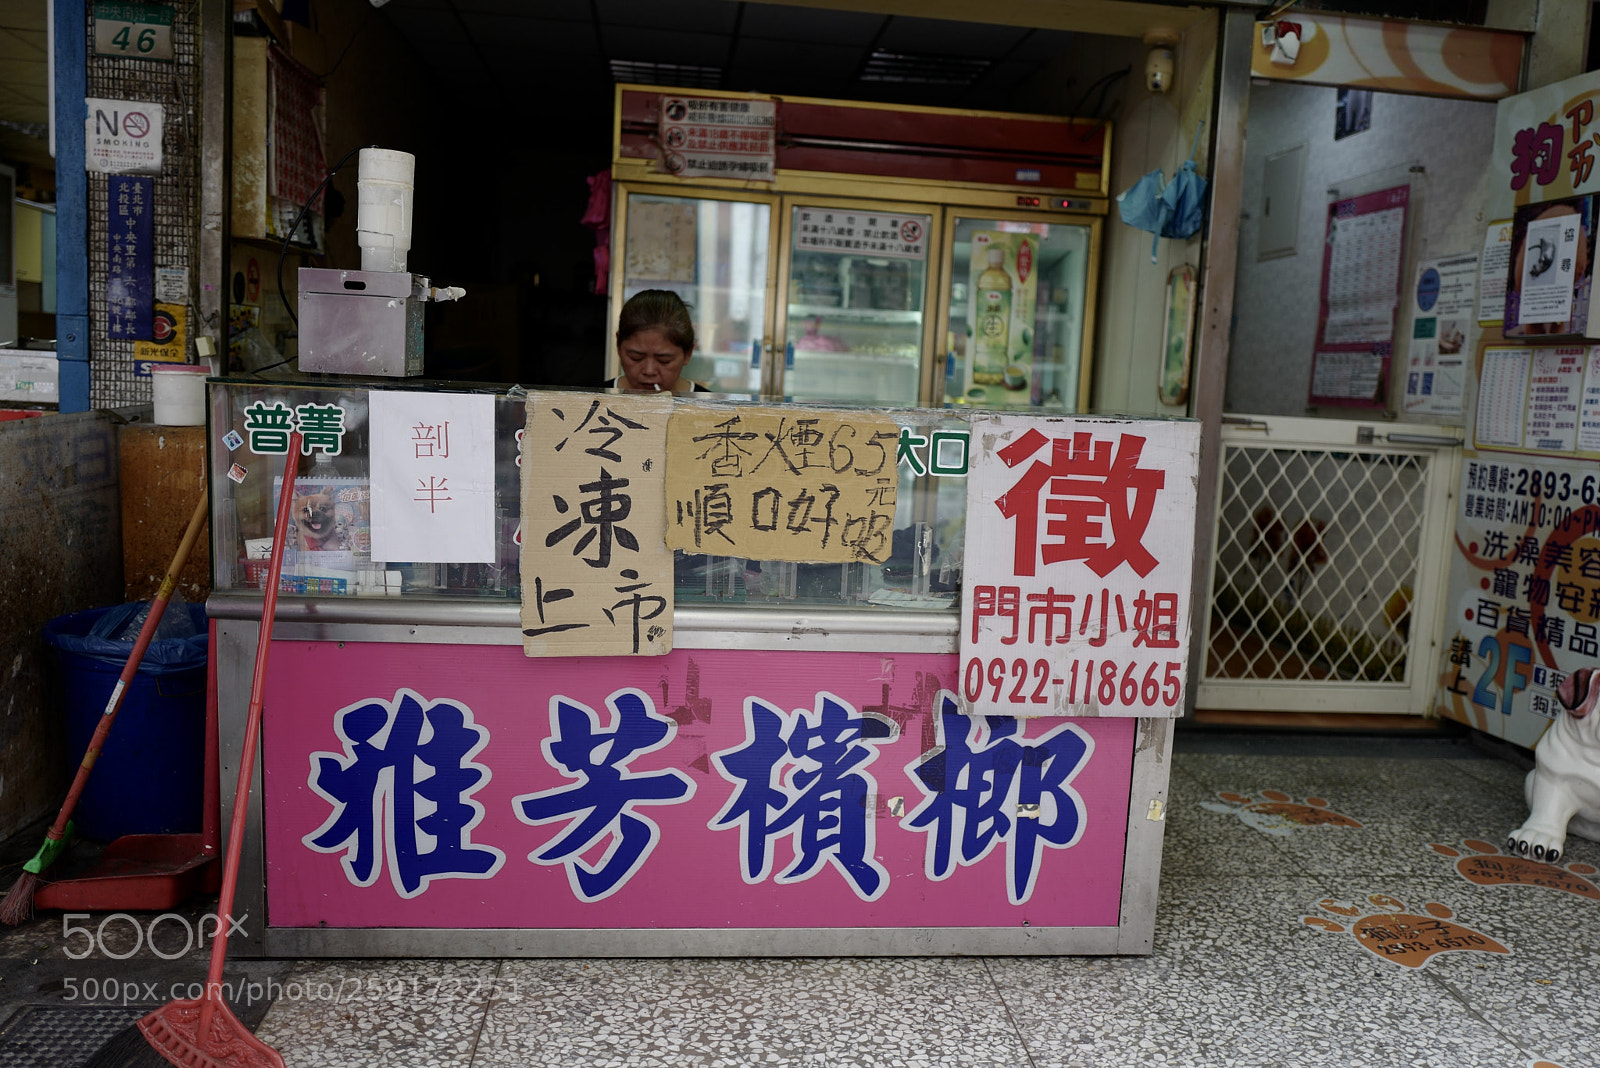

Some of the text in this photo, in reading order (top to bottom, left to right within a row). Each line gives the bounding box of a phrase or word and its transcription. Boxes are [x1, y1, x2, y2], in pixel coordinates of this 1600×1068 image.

[112, 27, 157, 53] 46
[96, 138, 150, 148] SMOKING
[117, 182, 130, 216] 北投區
[132, 182, 144, 217] 臺北市
[245, 401, 346, 455] 普菁
[411, 420, 452, 514] 剖半
[677, 483, 892, 565] 順口好吸
[994, 428, 1166, 578] 徵
[1482, 530, 1600, 580] 洗澡美容
[523, 569, 667, 654] 上市
[972, 585, 1180, 648] 門市小姐
[1477, 598, 1598, 658] 百貨精品
[964, 657, 1181, 706] 0922-118665
[1473, 635, 1531, 716] 2F
[303, 688, 1096, 905] 雅芳檳榔
[1376, 934, 1486, 956] 2893-6570
